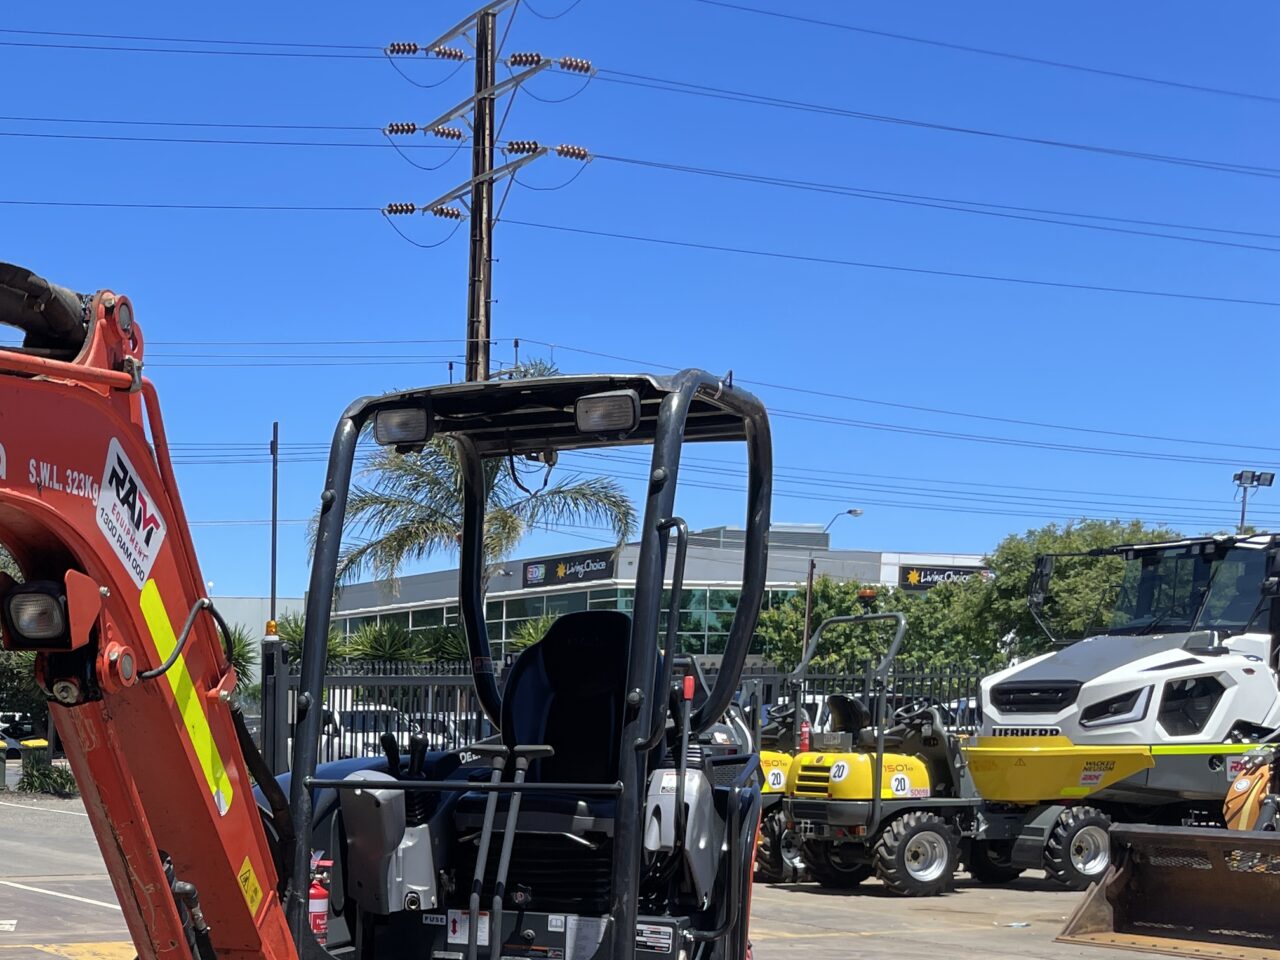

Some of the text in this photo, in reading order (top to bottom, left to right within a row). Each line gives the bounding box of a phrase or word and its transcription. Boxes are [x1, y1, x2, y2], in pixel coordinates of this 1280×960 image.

[29, 458, 63, 491] S.W.L.
[108, 452, 160, 548] RAM
[111, 502, 145, 561] EQUIPMENT
[100, 507, 145, 582] 1300 RAM 000
[772, 772, 782, 786] 20
[833, 764, 845, 779] 20
[894, 777, 906, 792] 20
[424, 915, 445, 923] FUSE
